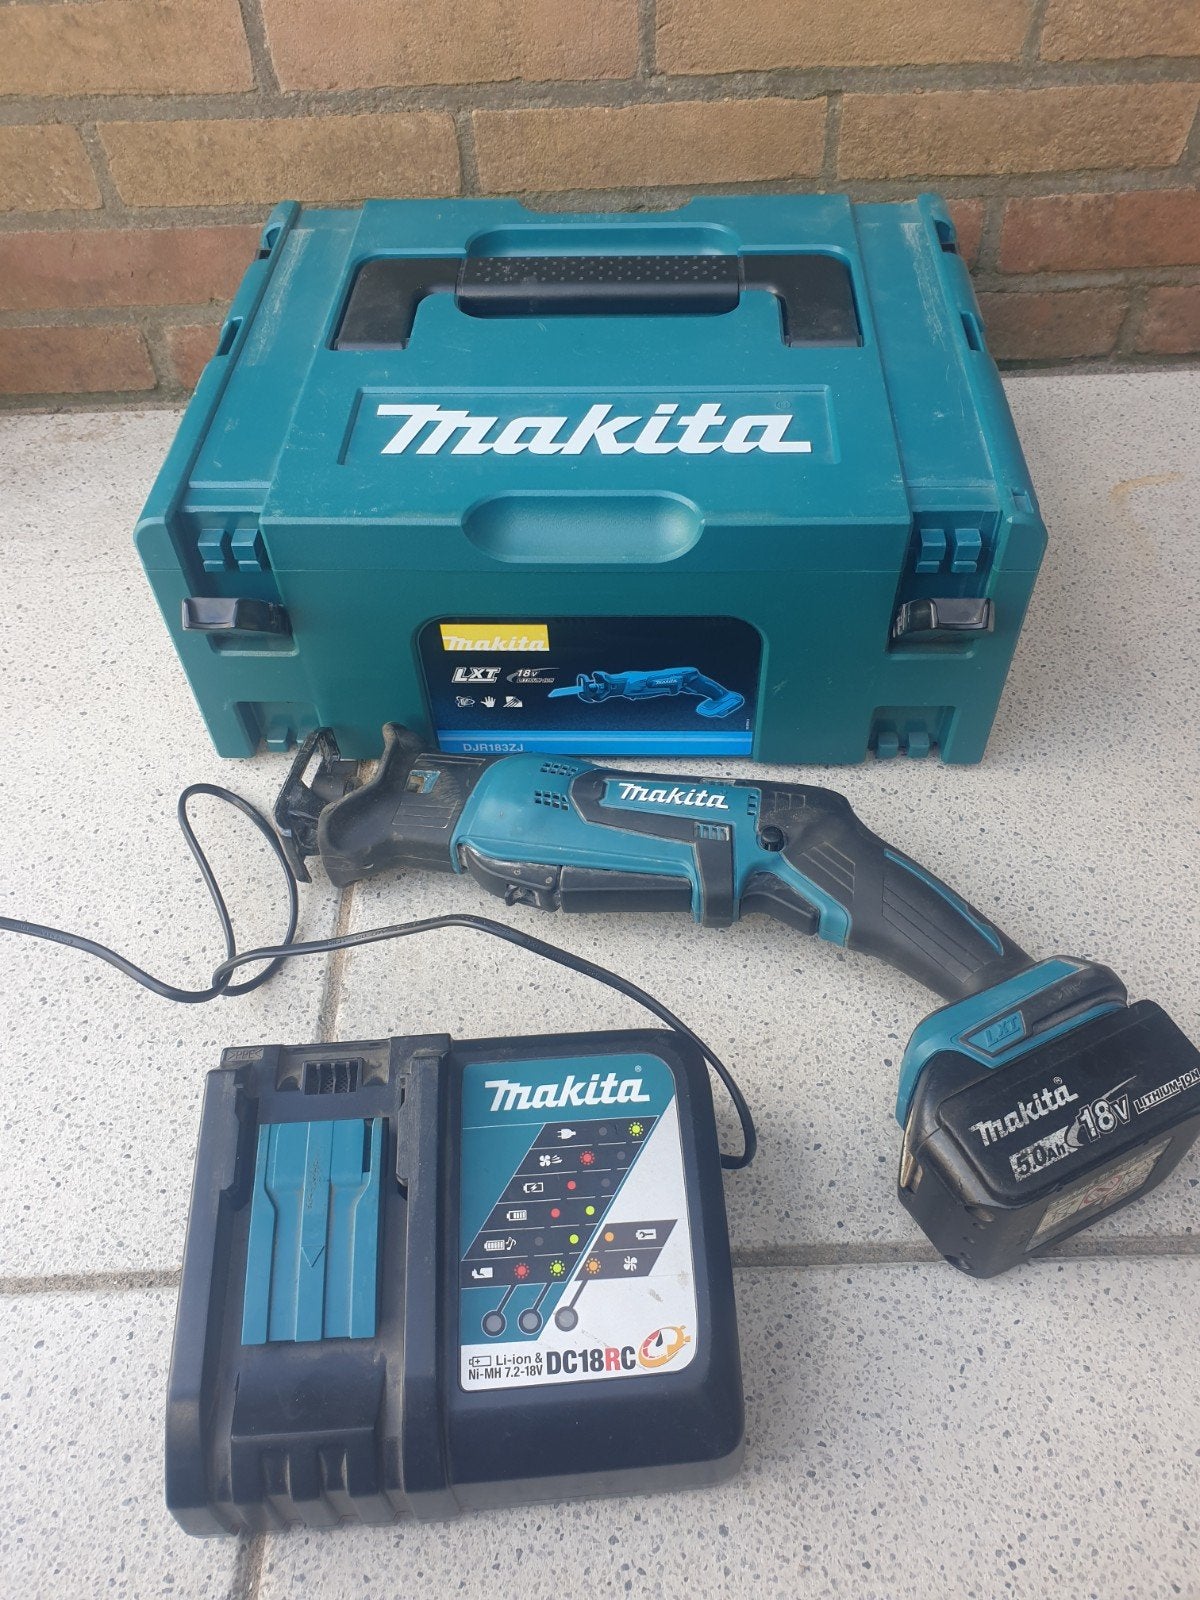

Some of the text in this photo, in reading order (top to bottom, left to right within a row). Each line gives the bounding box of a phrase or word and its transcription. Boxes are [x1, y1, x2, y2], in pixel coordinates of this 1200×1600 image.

[452, 667, 501, 683] LXT
[463, 743, 524, 752] DJR183ZJ
[984, 1016, 1020, 1047] LXT
[1077, 1094, 1131, 1142] 18V
[1133, 1068, 1200, 1114] LITHIUM-ION
[495, 1353, 543, 1366] Li-ion &
[546, 1345, 636, 1374] DC18RC
[468, 1364, 543, 1380] Ni-MH 7.2-18V
